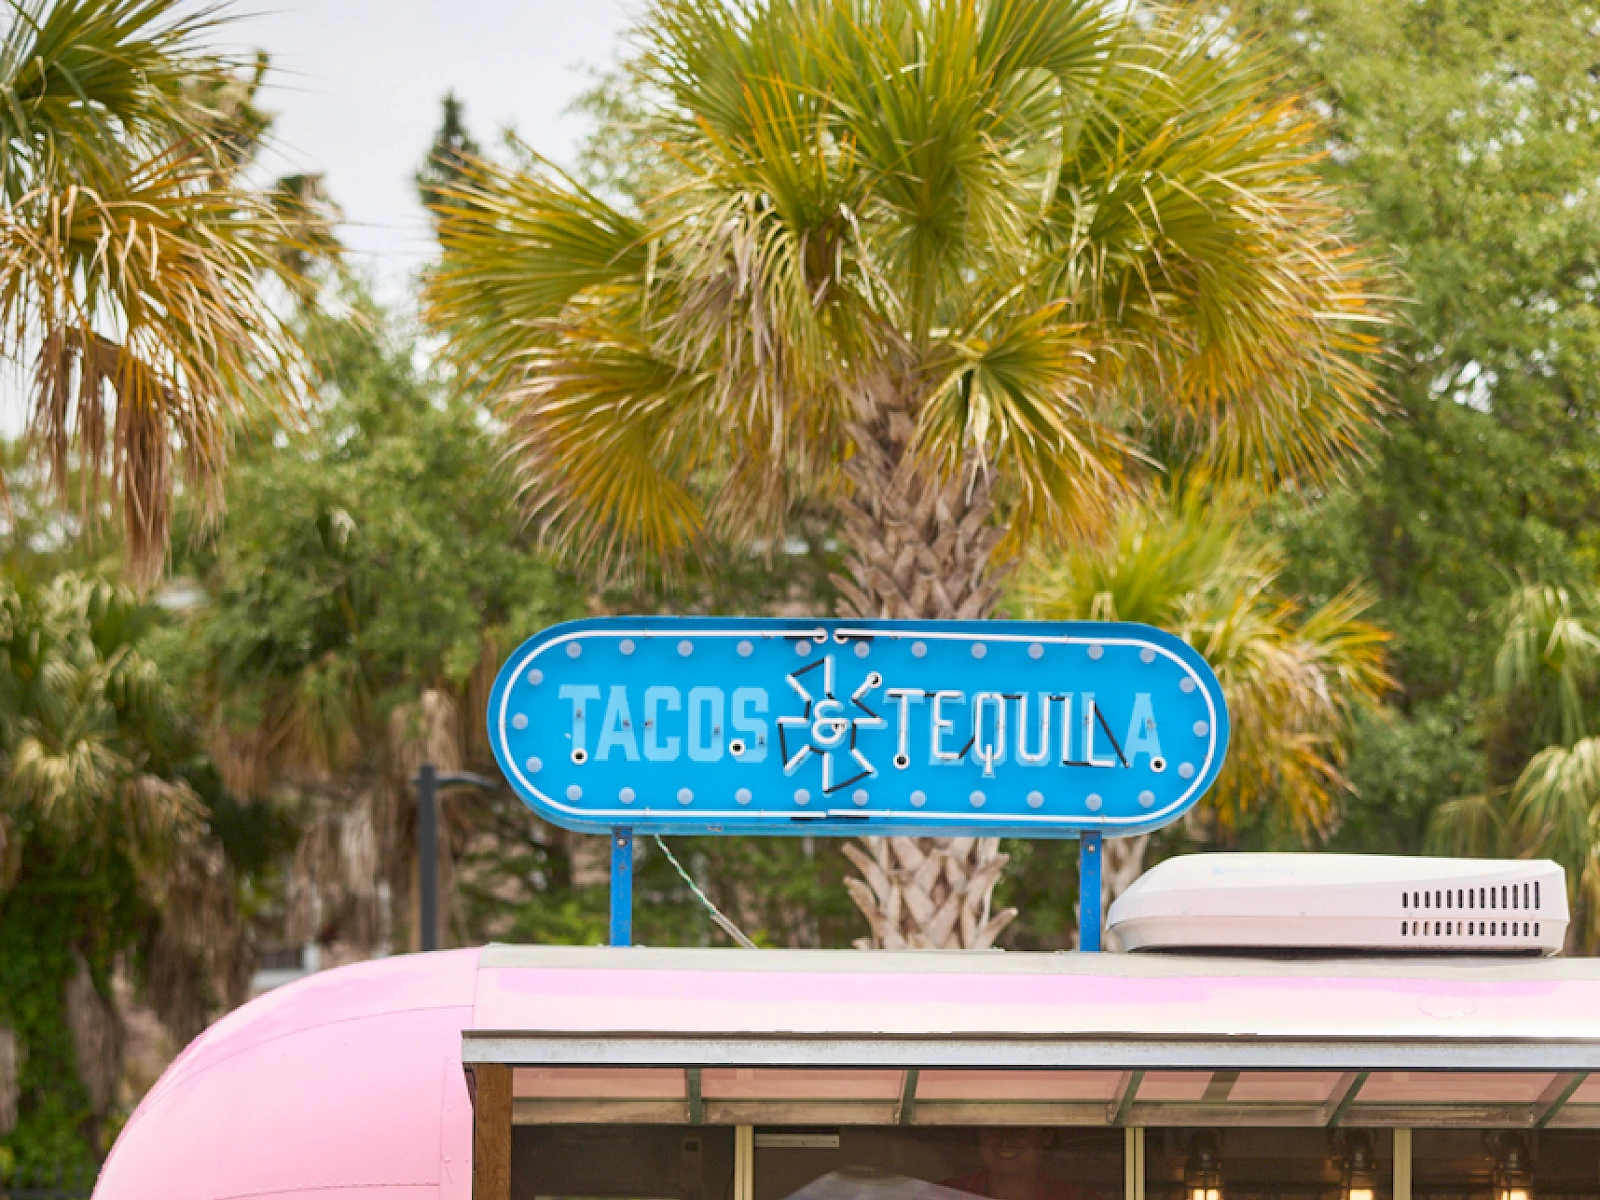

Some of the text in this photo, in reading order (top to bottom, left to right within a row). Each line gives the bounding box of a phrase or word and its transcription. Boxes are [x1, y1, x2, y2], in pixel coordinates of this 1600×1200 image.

[558, 684, 1164, 779] TACOS & TEQUILA
